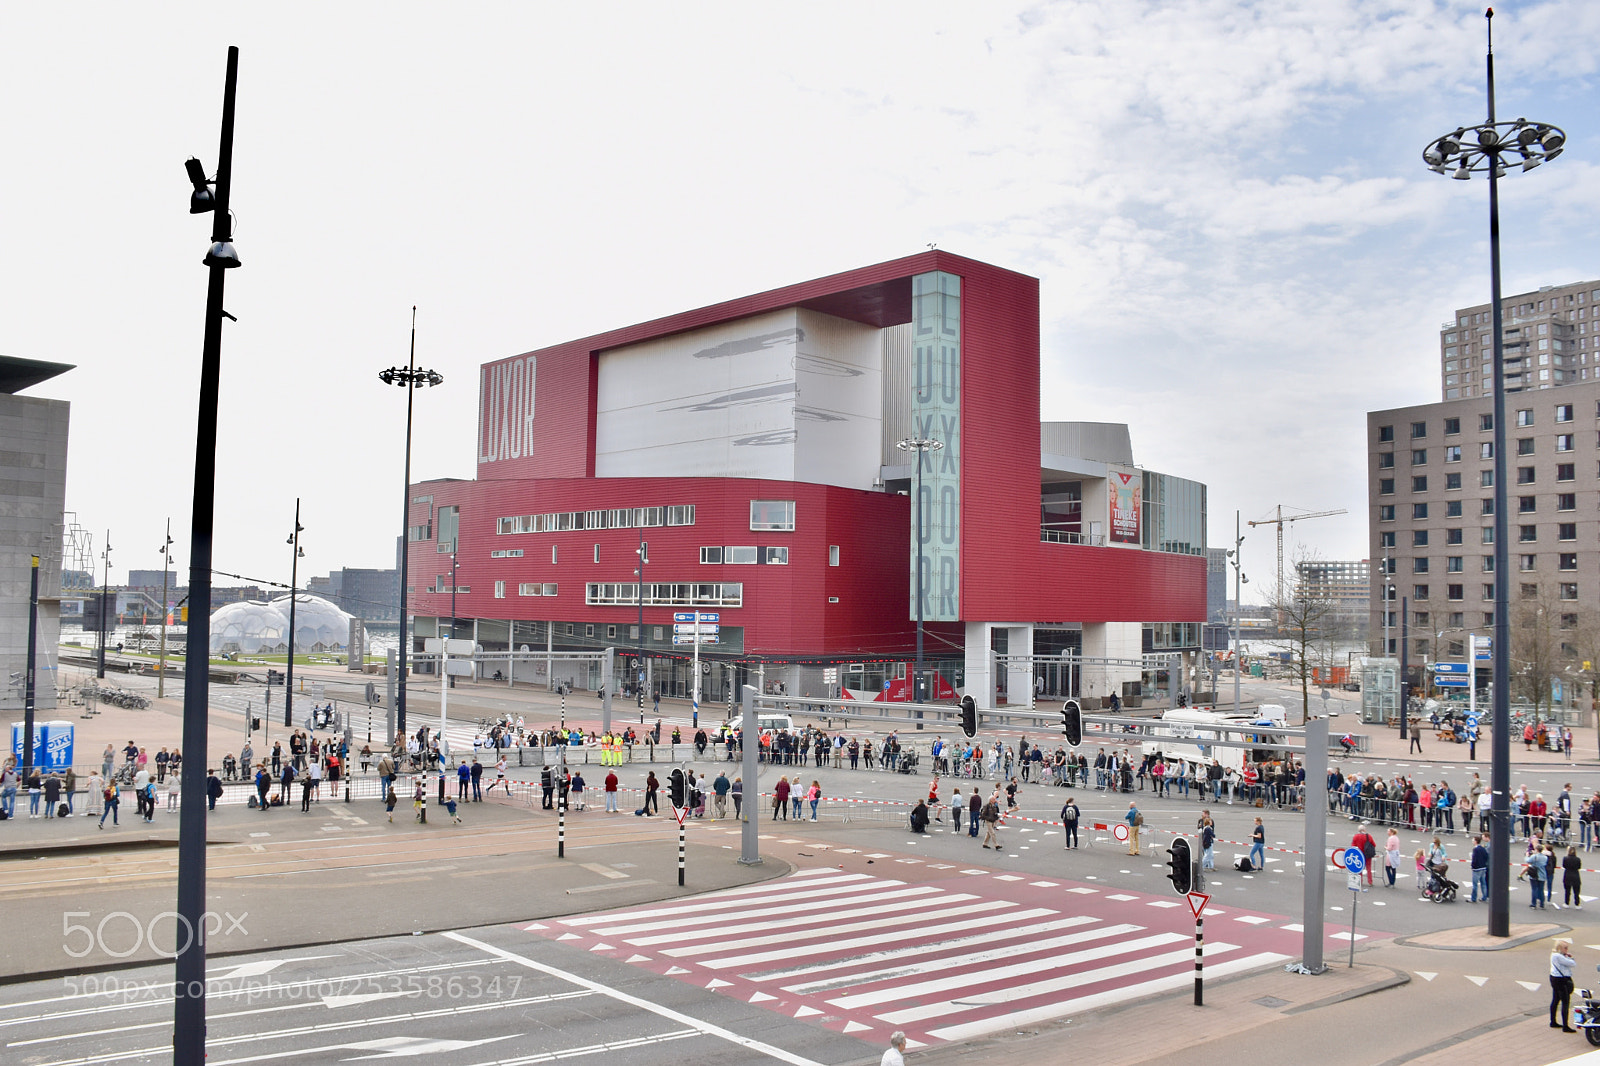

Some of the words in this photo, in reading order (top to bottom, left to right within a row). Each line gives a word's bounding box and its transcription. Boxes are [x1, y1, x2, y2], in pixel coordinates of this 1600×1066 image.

[479, 356, 537, 464] LUXOR
[939, 276, 956, 616] LUXOR
[1113, 508, 1137, 521] TINEKE
